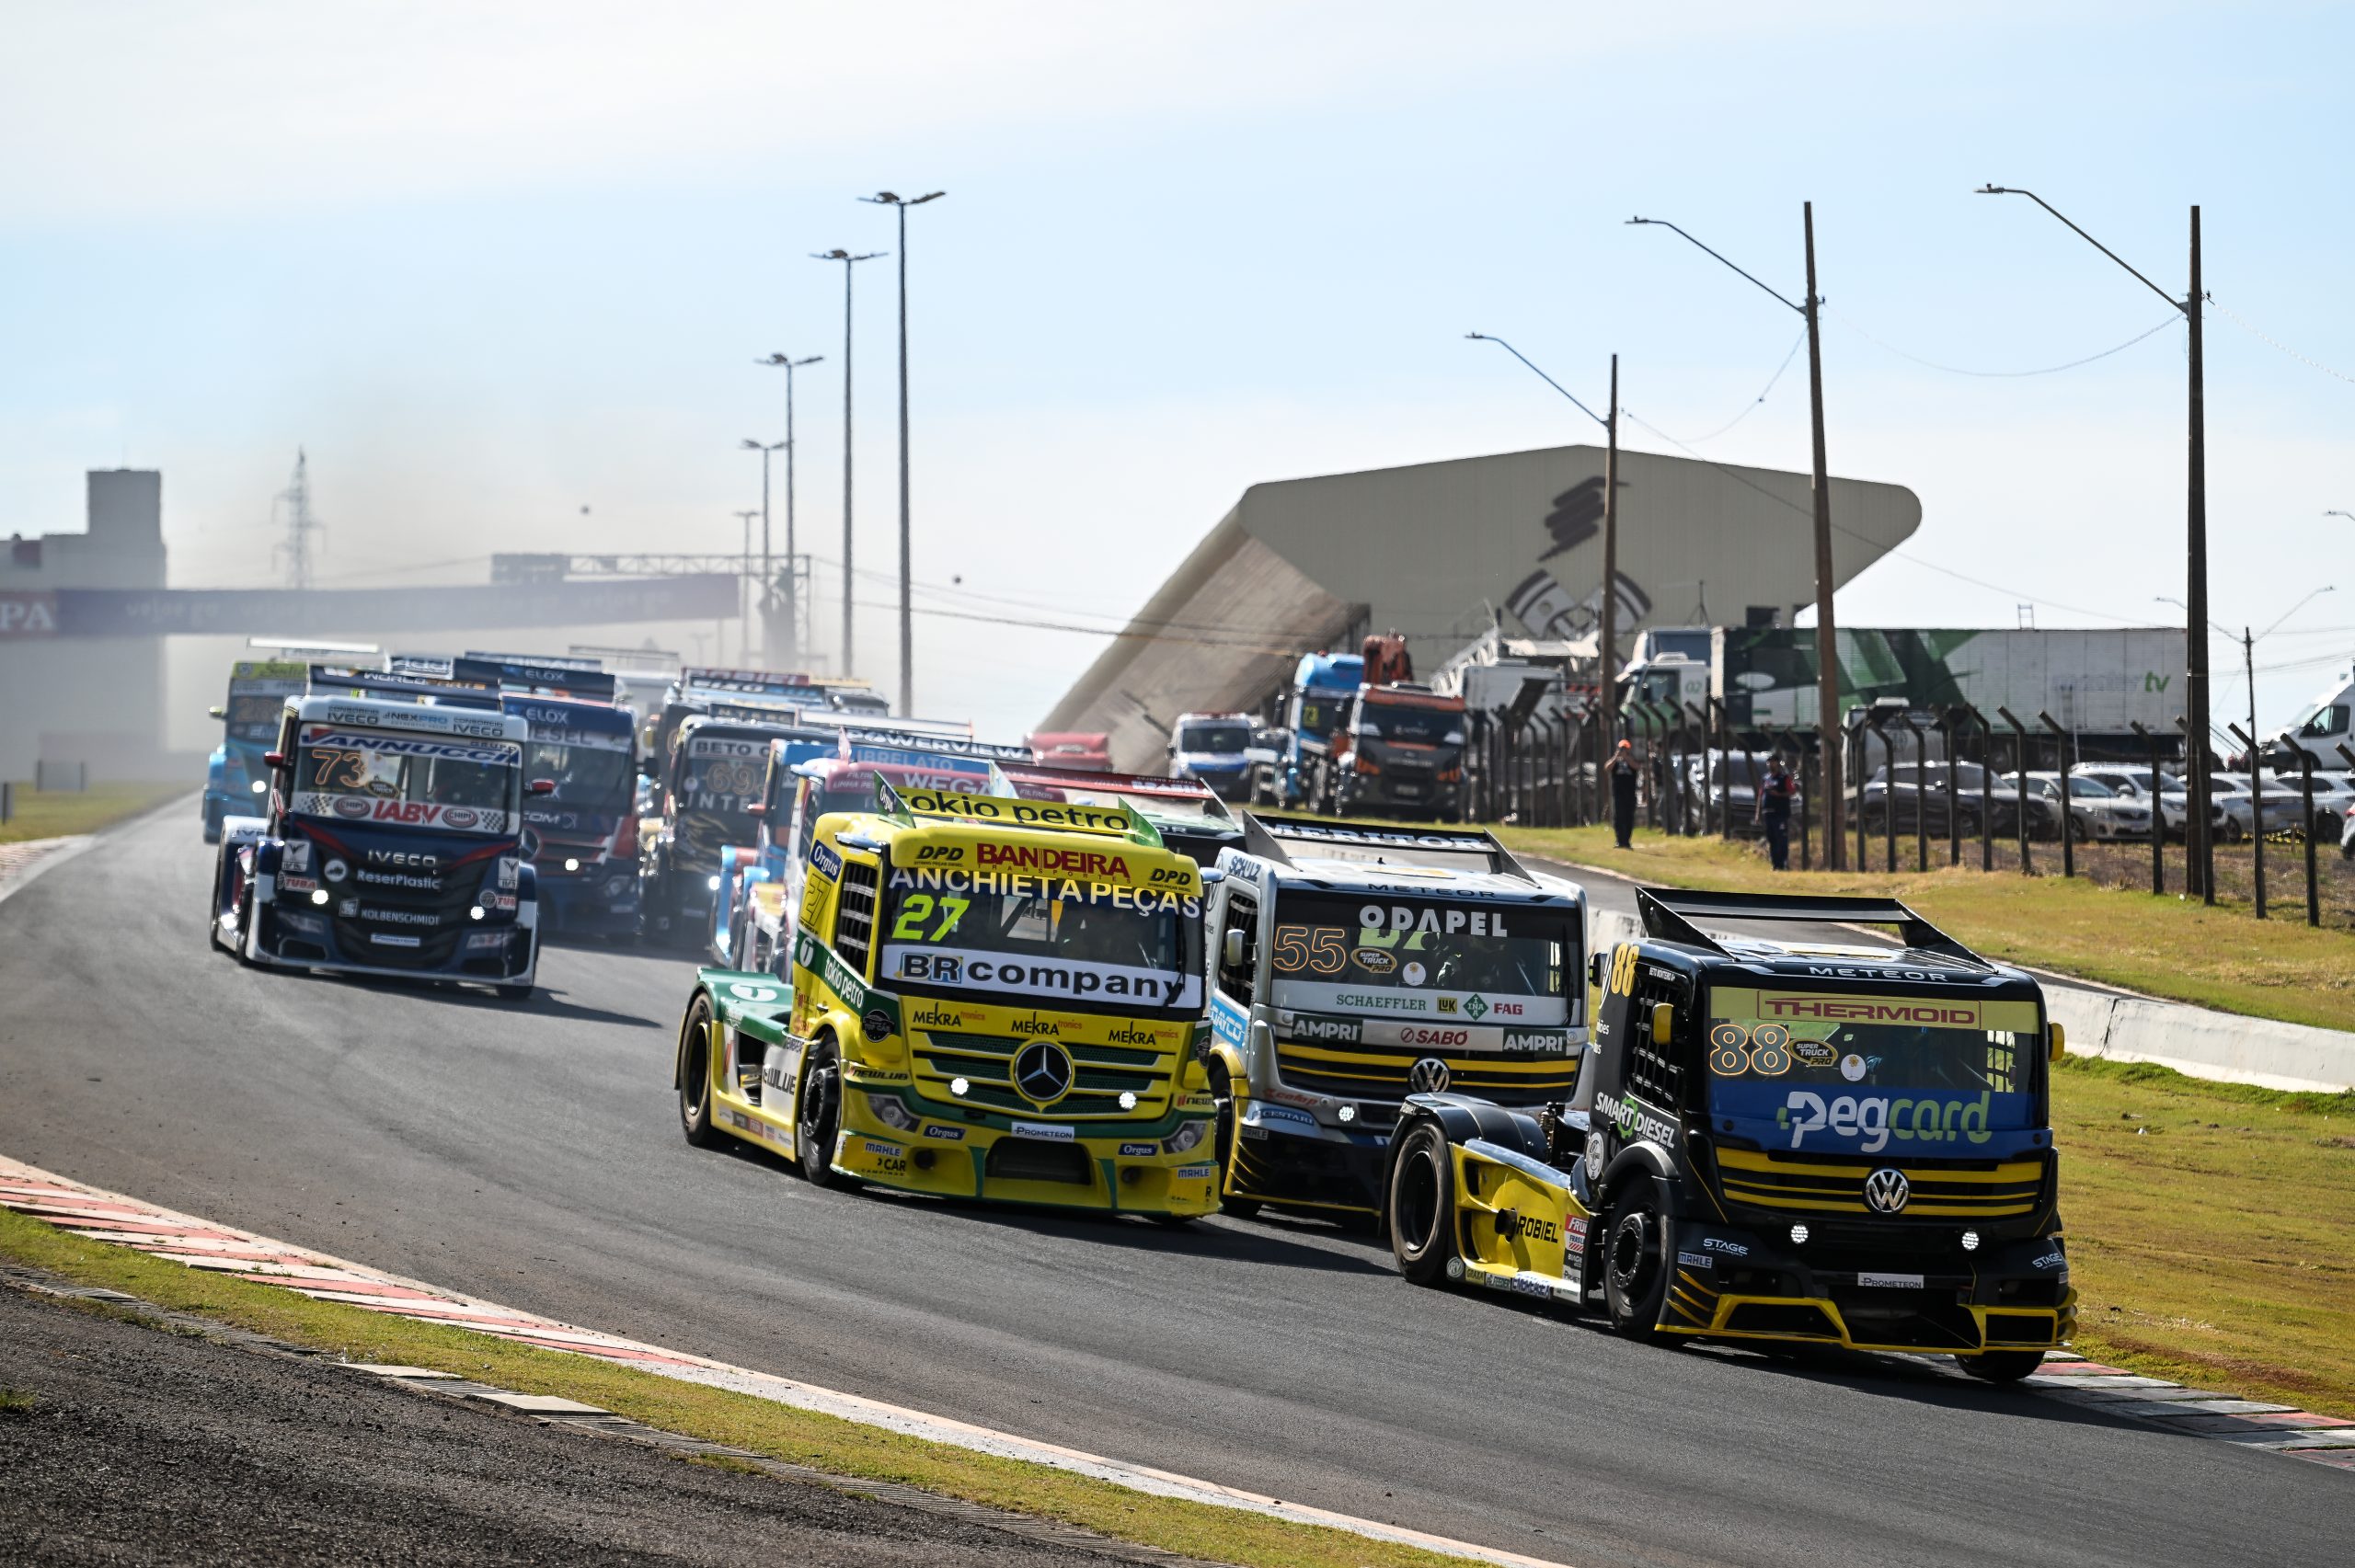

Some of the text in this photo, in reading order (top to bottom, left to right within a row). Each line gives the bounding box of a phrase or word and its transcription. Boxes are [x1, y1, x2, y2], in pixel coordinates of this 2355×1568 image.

[2144, 670, 2171, 693] tv
[327, 713, 379, 725] IVECO
[453, 724, 503, 737] IVECO
[301, 733, 520, 765] VANNUCCI
[312, 749, 367, 787] 73
[1012, 803, 1130, 830] petro
[1264, 822, 1488, 850] MERITOR
[368, 849, 436, 867] IVECO
[814, 844, 838, 876] Orgus
[916, 845, 964, 861] DPD
[976, 842, 1131, 878] BANDEIRA
[357, 869, 442, 889] ReserPlastic
[977, 863, 1132, 884] TRANSPORTES
[1149, 868, 1191, 885] DPD
[889, 867, 1200, 919] ANCHIETA PEÇAS
[1368, 883, 1496, 898] METEOR
[891, 894, 971, 943] 27
[1359, 905, 1508, 938] ODAPEL
[1272, 925, 1347, 974] 55
[1360, 951, 1380, 959] SUPER
[1362, 956, 1389, 965] TRUCK
[1372, 965, 1391, 973] PRO
[1611, 942, 1639, 997] 88
[1809, 966, 1948, 983] METEOR
[824, 956, 841, 990] tokio
[840, 976, 865, 1009] petro
[1336, 994, 1426, 1011] SCHAEFFLER
[1494, 1002, 1523, 1015] FAG
[1764, 999, 1976, 1025] THERMOID
[1292, 1020, 1359, 1042] AMPRI
[1503, 1034, 1563, 1053] AMPRI
[1709, 1023, 1791, 1075] 88
[1799, 1048, 1829, 1058] TRUCK
[1810, 1057, 1832, 1066] PRO
[1595, 1092, 1635, 1127] SMART
[1634, 1112, 1675, 1149] DIESEL
[928, 1127, 959, 1139] Orgus
[1015, 1126, 1073, 1139] PROMETEON
[865, 1142, 902, 1157] MAHLE
[1123, 1145, 1154, 1157] Orgus
[1178, 1168, 1211, 1179] MAHLE
[1518, 1216, 1558, 1243] ROBIEL
[1703, 1238, 1749, 1255] STAGE
[1679, 1253, 1712, 1267] MAHLE
[2032, 1252, 2062, 1268] STAGE
[1860, 1276, 1923, 1288] PROMETEON
